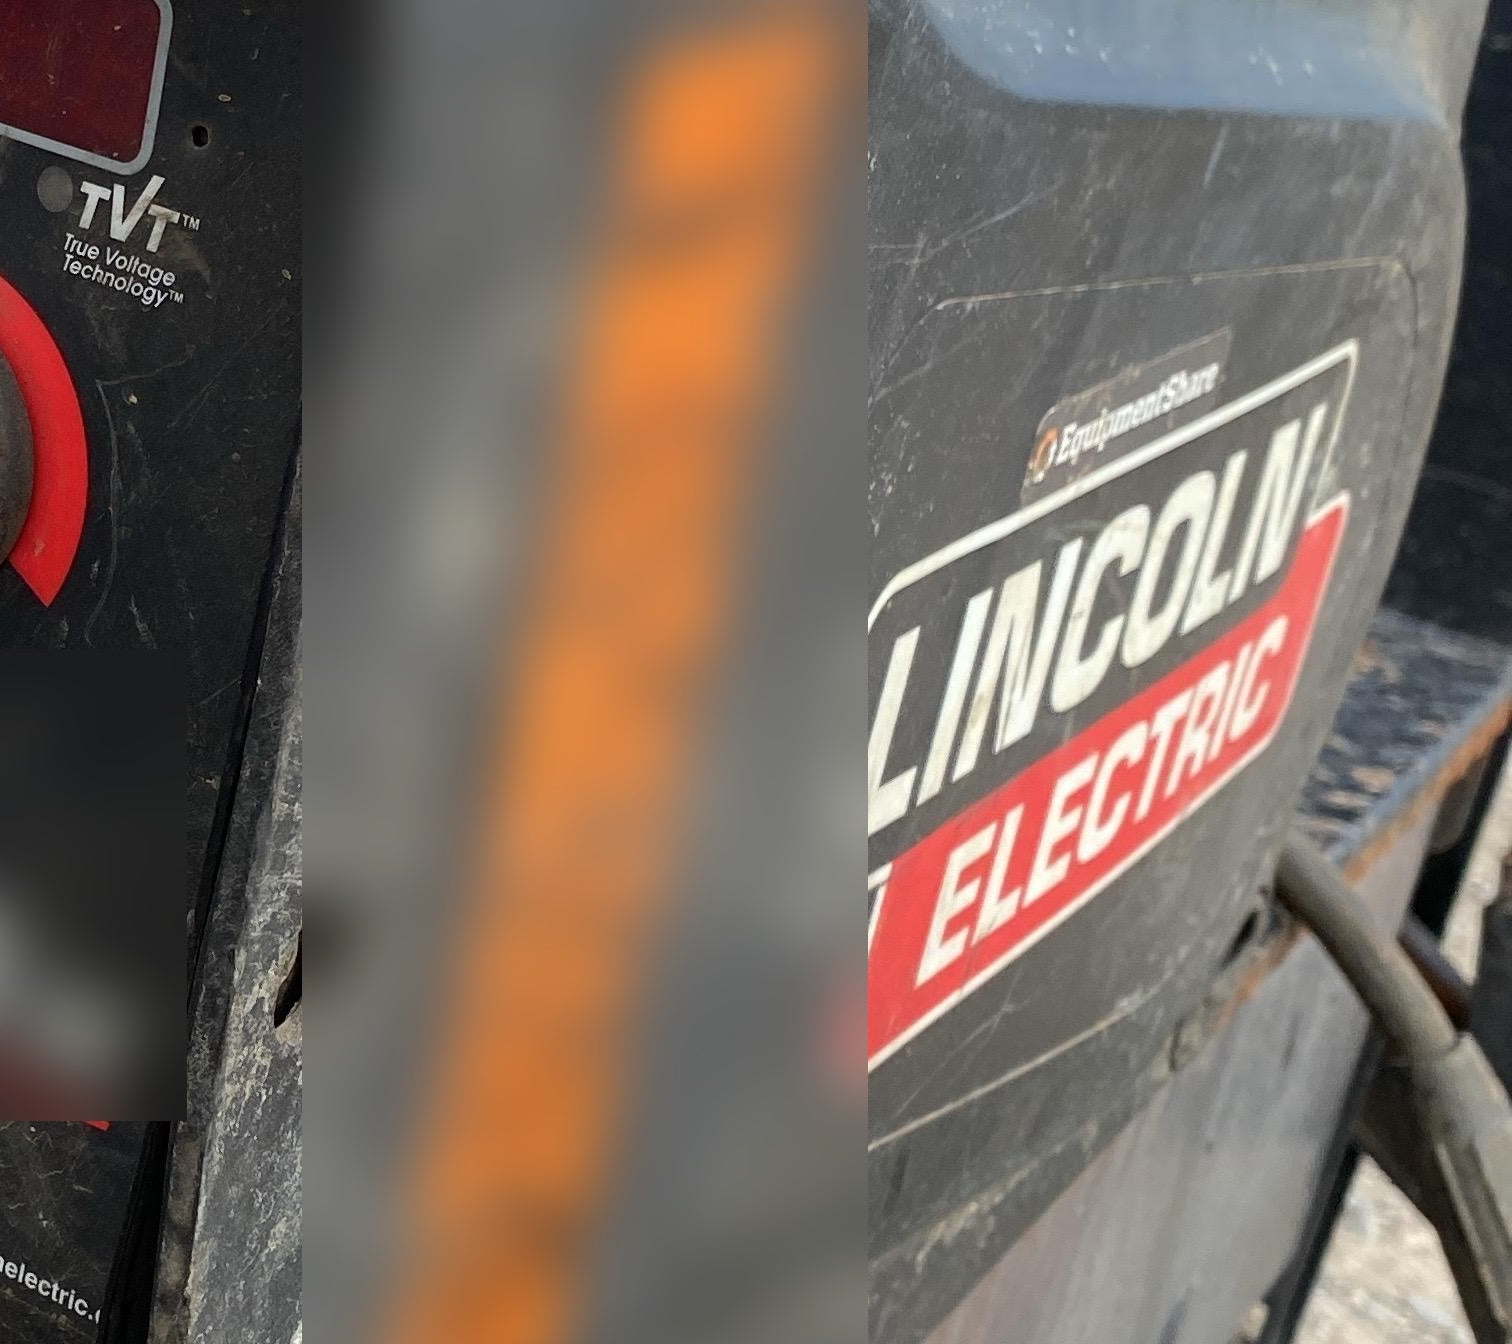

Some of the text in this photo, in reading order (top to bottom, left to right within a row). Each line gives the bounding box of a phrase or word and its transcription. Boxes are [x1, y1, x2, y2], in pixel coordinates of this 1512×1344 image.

[63, 232, 176, 287] True Voltage
[868, 401, 1328, 838] LINCOLN
[915, 614, 1290, 989] ELECTRIC
